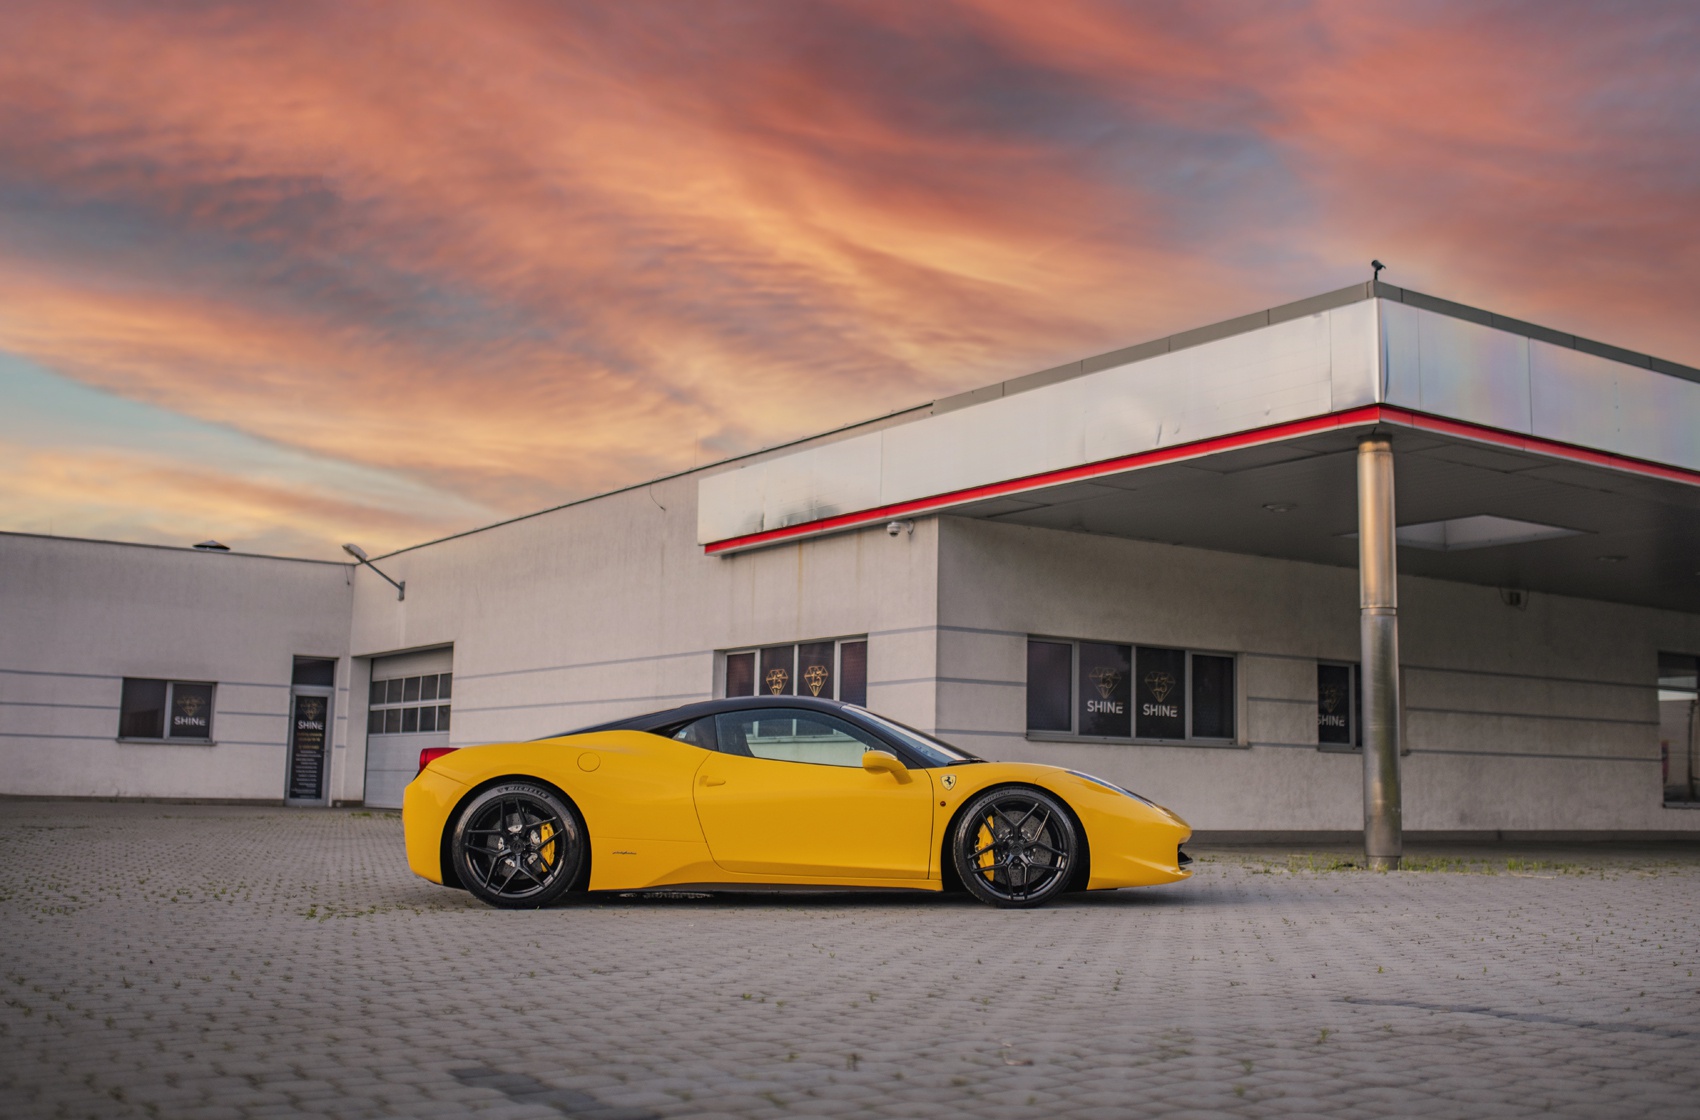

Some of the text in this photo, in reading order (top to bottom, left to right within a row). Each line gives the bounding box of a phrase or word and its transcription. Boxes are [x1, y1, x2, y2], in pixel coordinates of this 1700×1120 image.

[1087, 700, 1123, 714] SHINE
[1143, 703, 1178, 718] SHINE
[174, 715, 206, 726] SHINE
[297, 720, 323, 730] SHINE
[507, 785, 549, 799] MICHELIN
